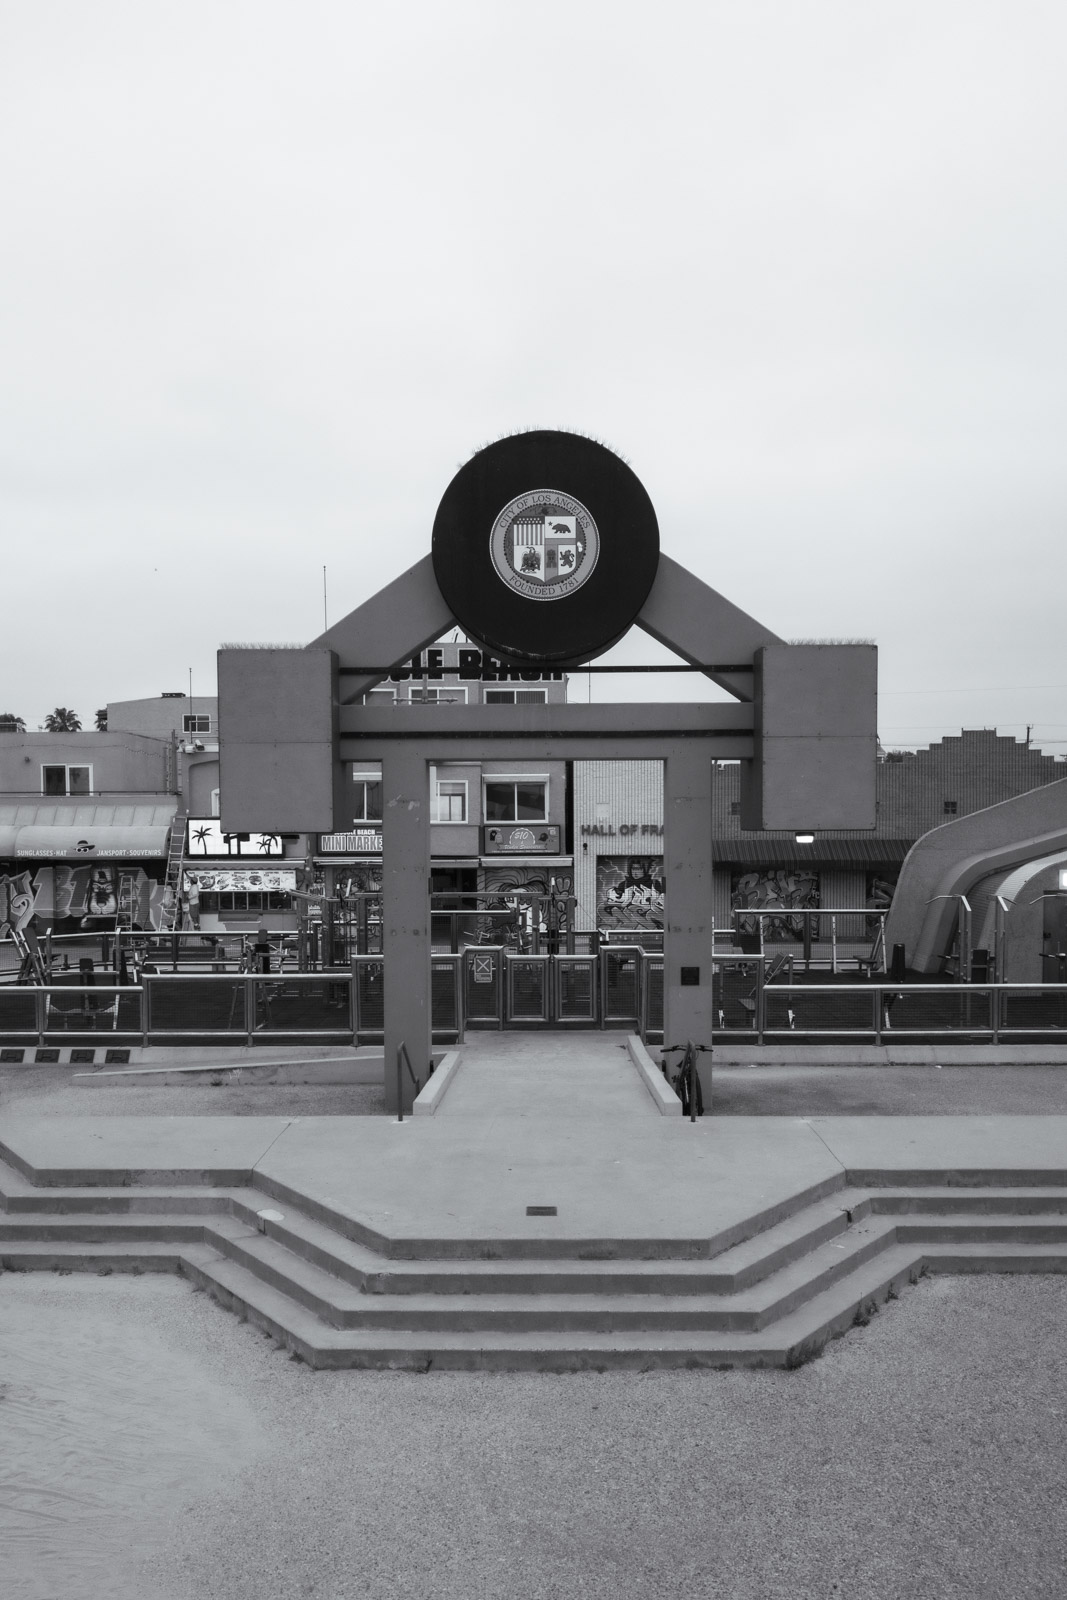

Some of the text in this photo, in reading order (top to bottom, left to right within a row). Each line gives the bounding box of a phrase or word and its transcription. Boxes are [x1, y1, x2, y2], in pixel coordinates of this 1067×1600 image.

[500, 495, 591, 529] CITY OF LOS ANGELES
[509, 575, 579, 595] FOUNDED 1781
[581, 824, 617, 837] HALL
[619, 824, 639, 837] OF
[321, 835, 346, 851] MINI
[96, 849, 162, 857] JANSPORT SOUVENIRS
